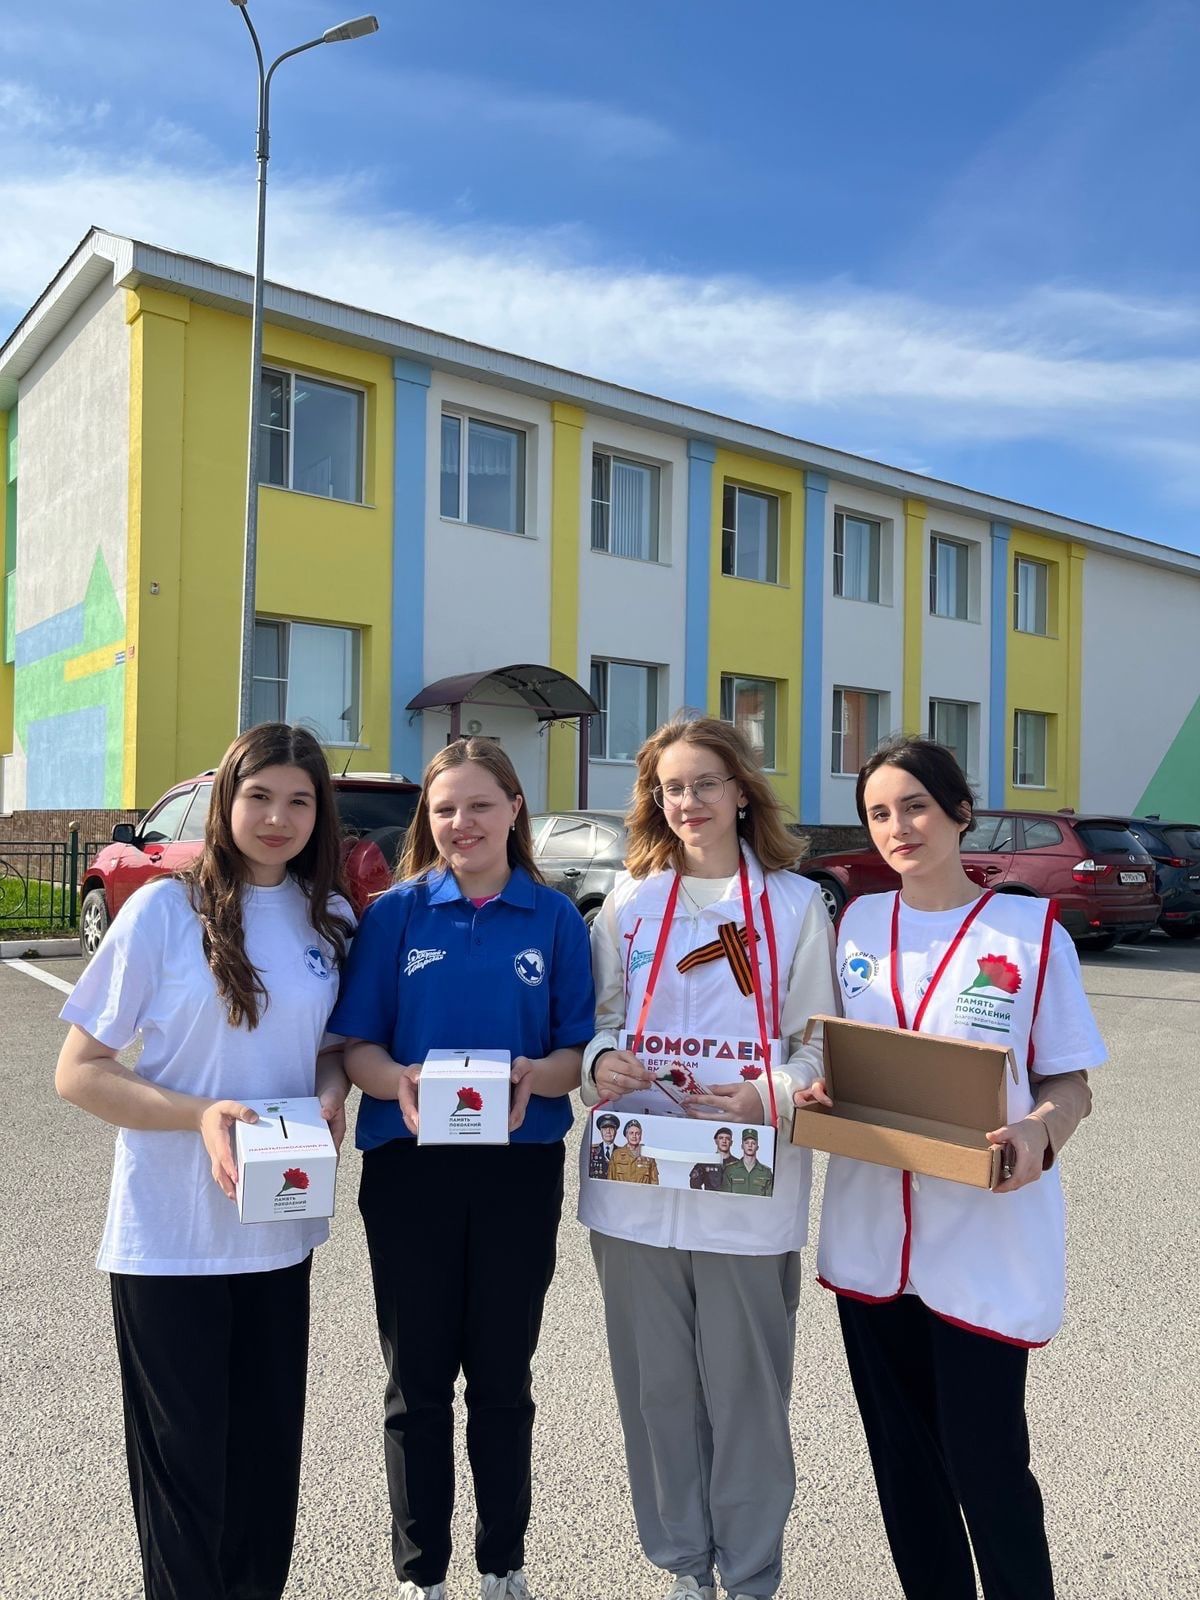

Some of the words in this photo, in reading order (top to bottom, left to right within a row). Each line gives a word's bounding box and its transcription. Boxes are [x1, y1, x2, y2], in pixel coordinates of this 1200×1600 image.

[957, 997, 994, 1008] ПАМЯТЬ
[955, 1005, 1011, 1021] ПОКОЛЕНИЙ
[626, 1034, 772, 1061] ПОМОГАЕМ
[647, 1058, 699, 1069] ВЕТЕАМ
